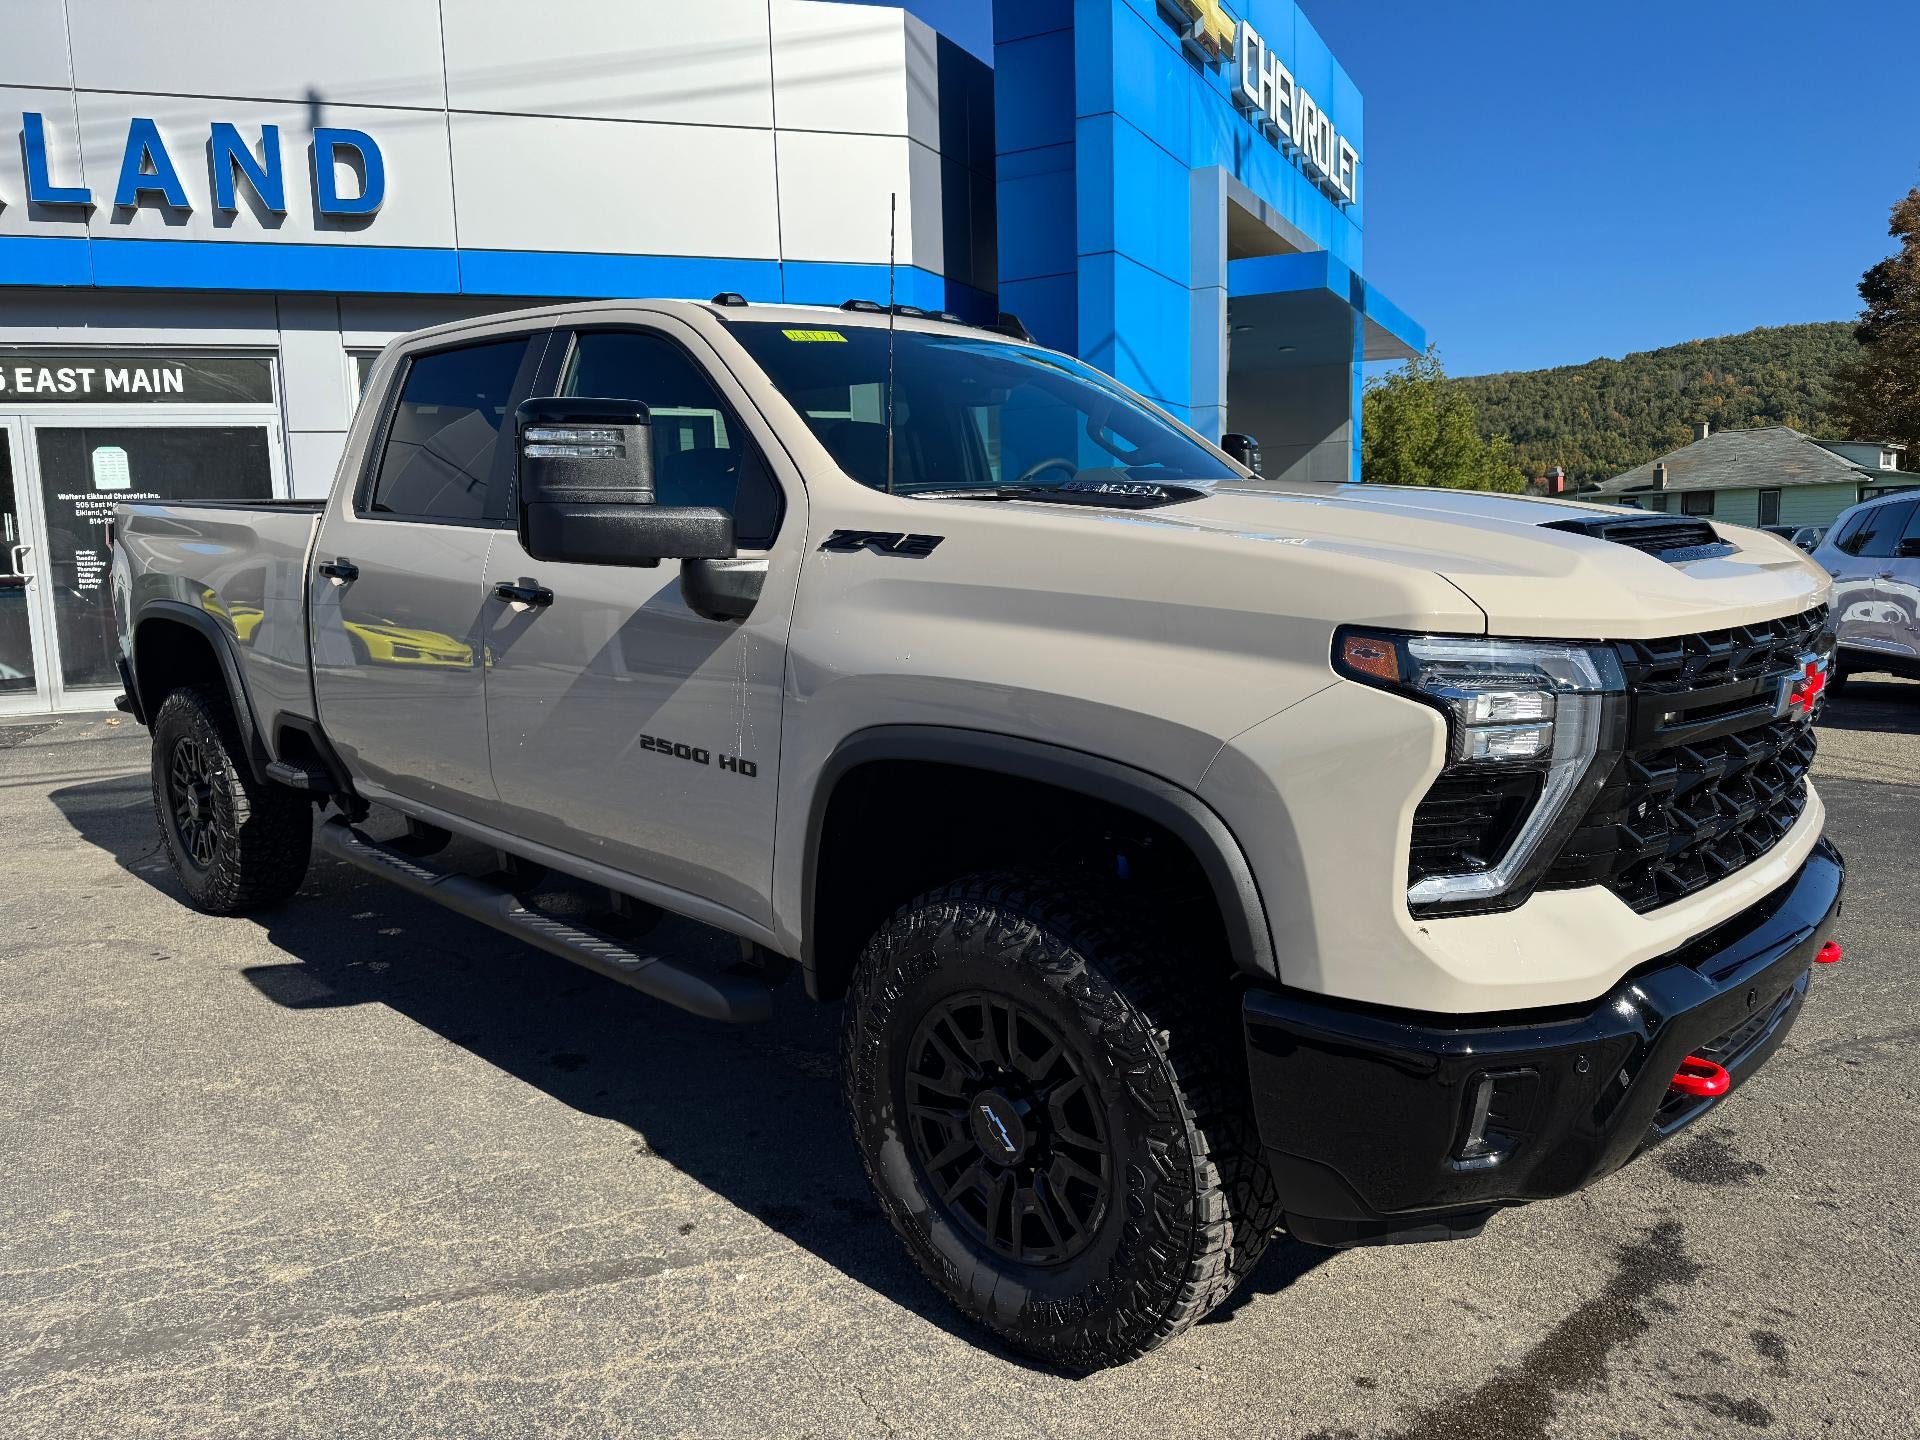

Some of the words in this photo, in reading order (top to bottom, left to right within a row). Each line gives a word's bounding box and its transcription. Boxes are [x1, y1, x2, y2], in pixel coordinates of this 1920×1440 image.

[1239, 19, 1359, 205] CHEVROLET
[15, 367, 96, 393] EAST
[104, 367, 184, 393] MAIN
[86, 492, 112, 500] Elkland
[113, 492, 147, 500] Chevrolet
[639, 733, 710, 766] 2500
[718, 753, 757, 778] HD
